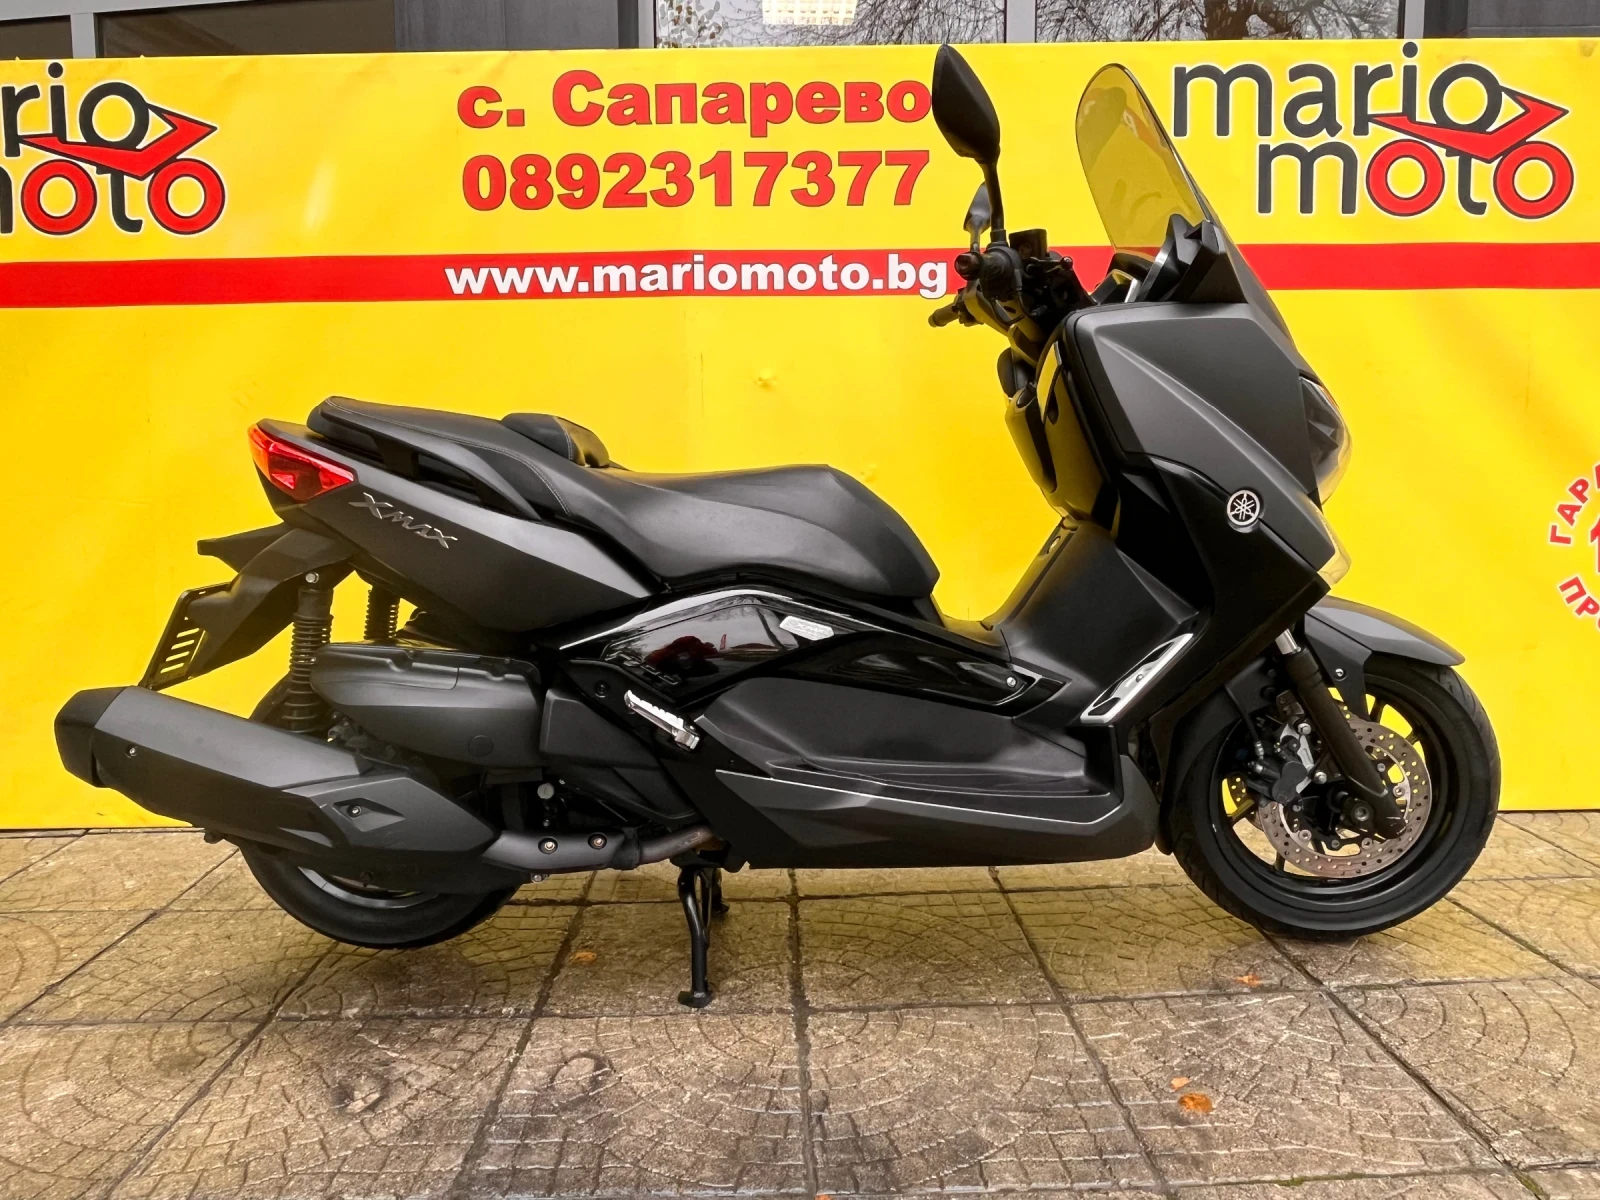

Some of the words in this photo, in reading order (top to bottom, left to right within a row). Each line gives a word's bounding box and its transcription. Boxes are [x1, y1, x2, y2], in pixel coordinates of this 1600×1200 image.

[457, 85, 525, 129] с.
[552, 69, 931, 138] Сапарево
[1173, 41, 1503, 138] mario
[462, 150, 931, 211] 0892317377
[1258, 138, 1575, 219] moto
[444, 254, 948, 299] www.mariomoto.bg
[348, 491, 459, 549] XMAX
